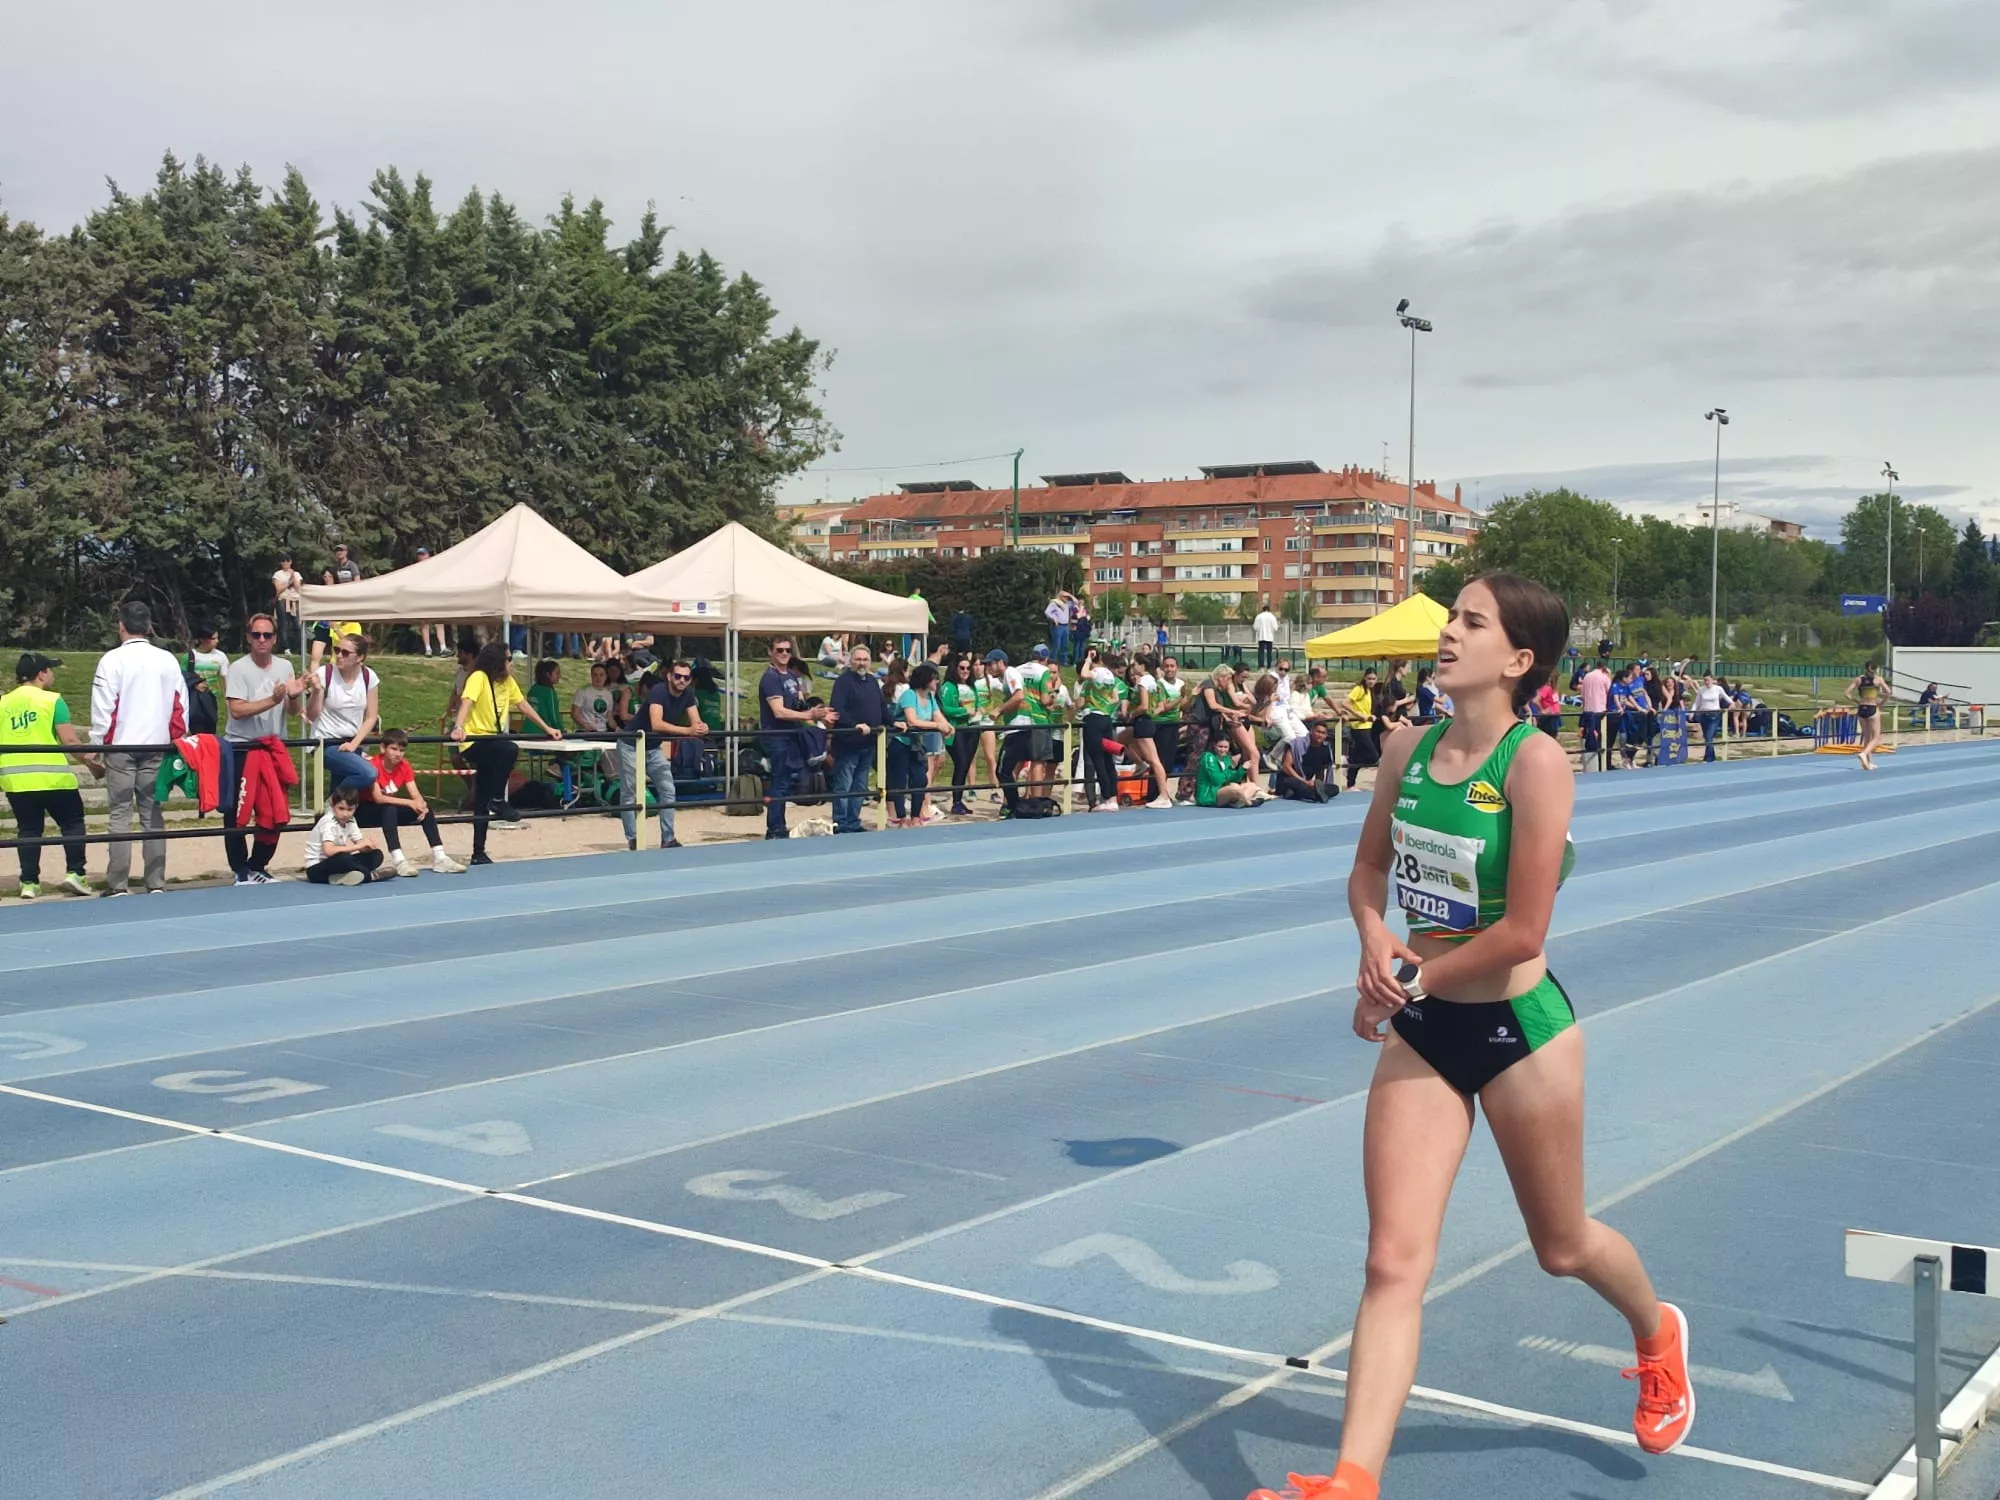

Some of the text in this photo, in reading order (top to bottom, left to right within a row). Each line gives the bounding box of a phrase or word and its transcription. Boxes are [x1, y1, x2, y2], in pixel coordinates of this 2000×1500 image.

[11, 709, 37, 730] Life
[1405, 833, 1456, 859] Iberdrola
[151, 1070, 330, 1103] 5
[372, 1120, 532, 1156] 4
[685, 1169, 907, 1220] 3
[1030, 1233, 1280, 1294] 2
